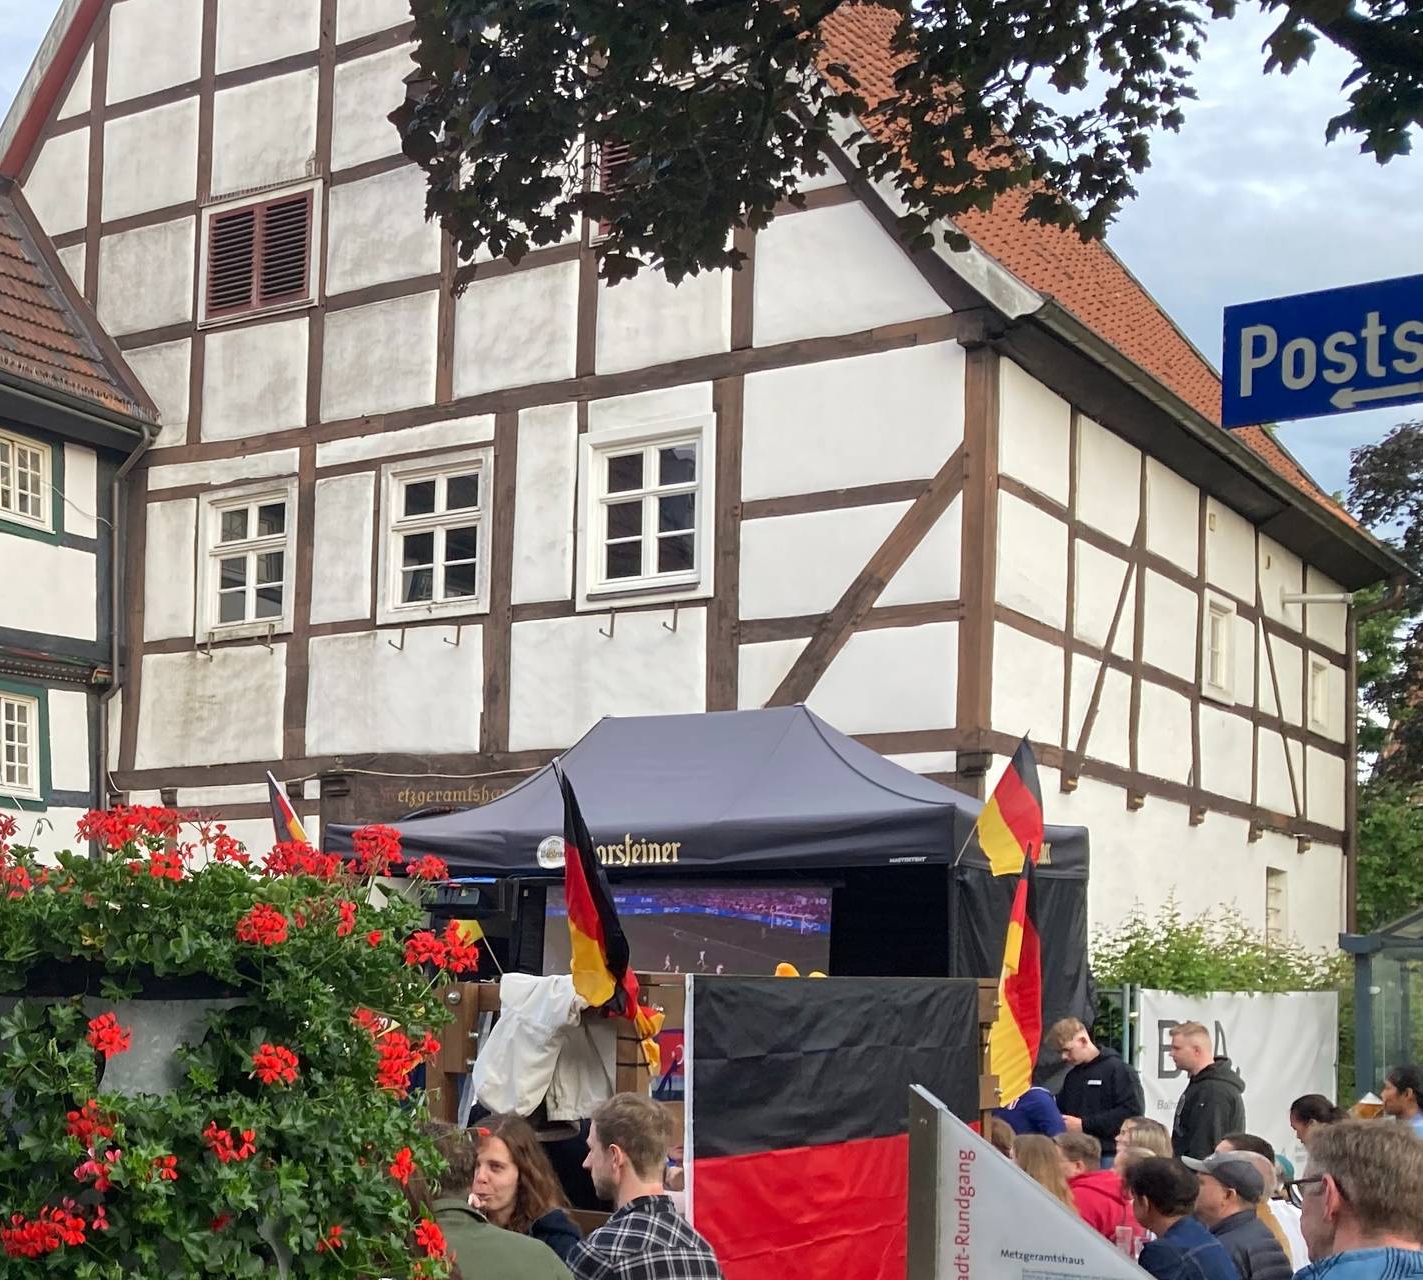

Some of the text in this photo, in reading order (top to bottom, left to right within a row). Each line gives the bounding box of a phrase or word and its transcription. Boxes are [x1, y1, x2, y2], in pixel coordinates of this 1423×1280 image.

[1239, 311, 1423, 398] Posts
[591, 833, 681, 867] arsteiner
[1000, 1249, 1086, 1266] Metzgeramtshaus
